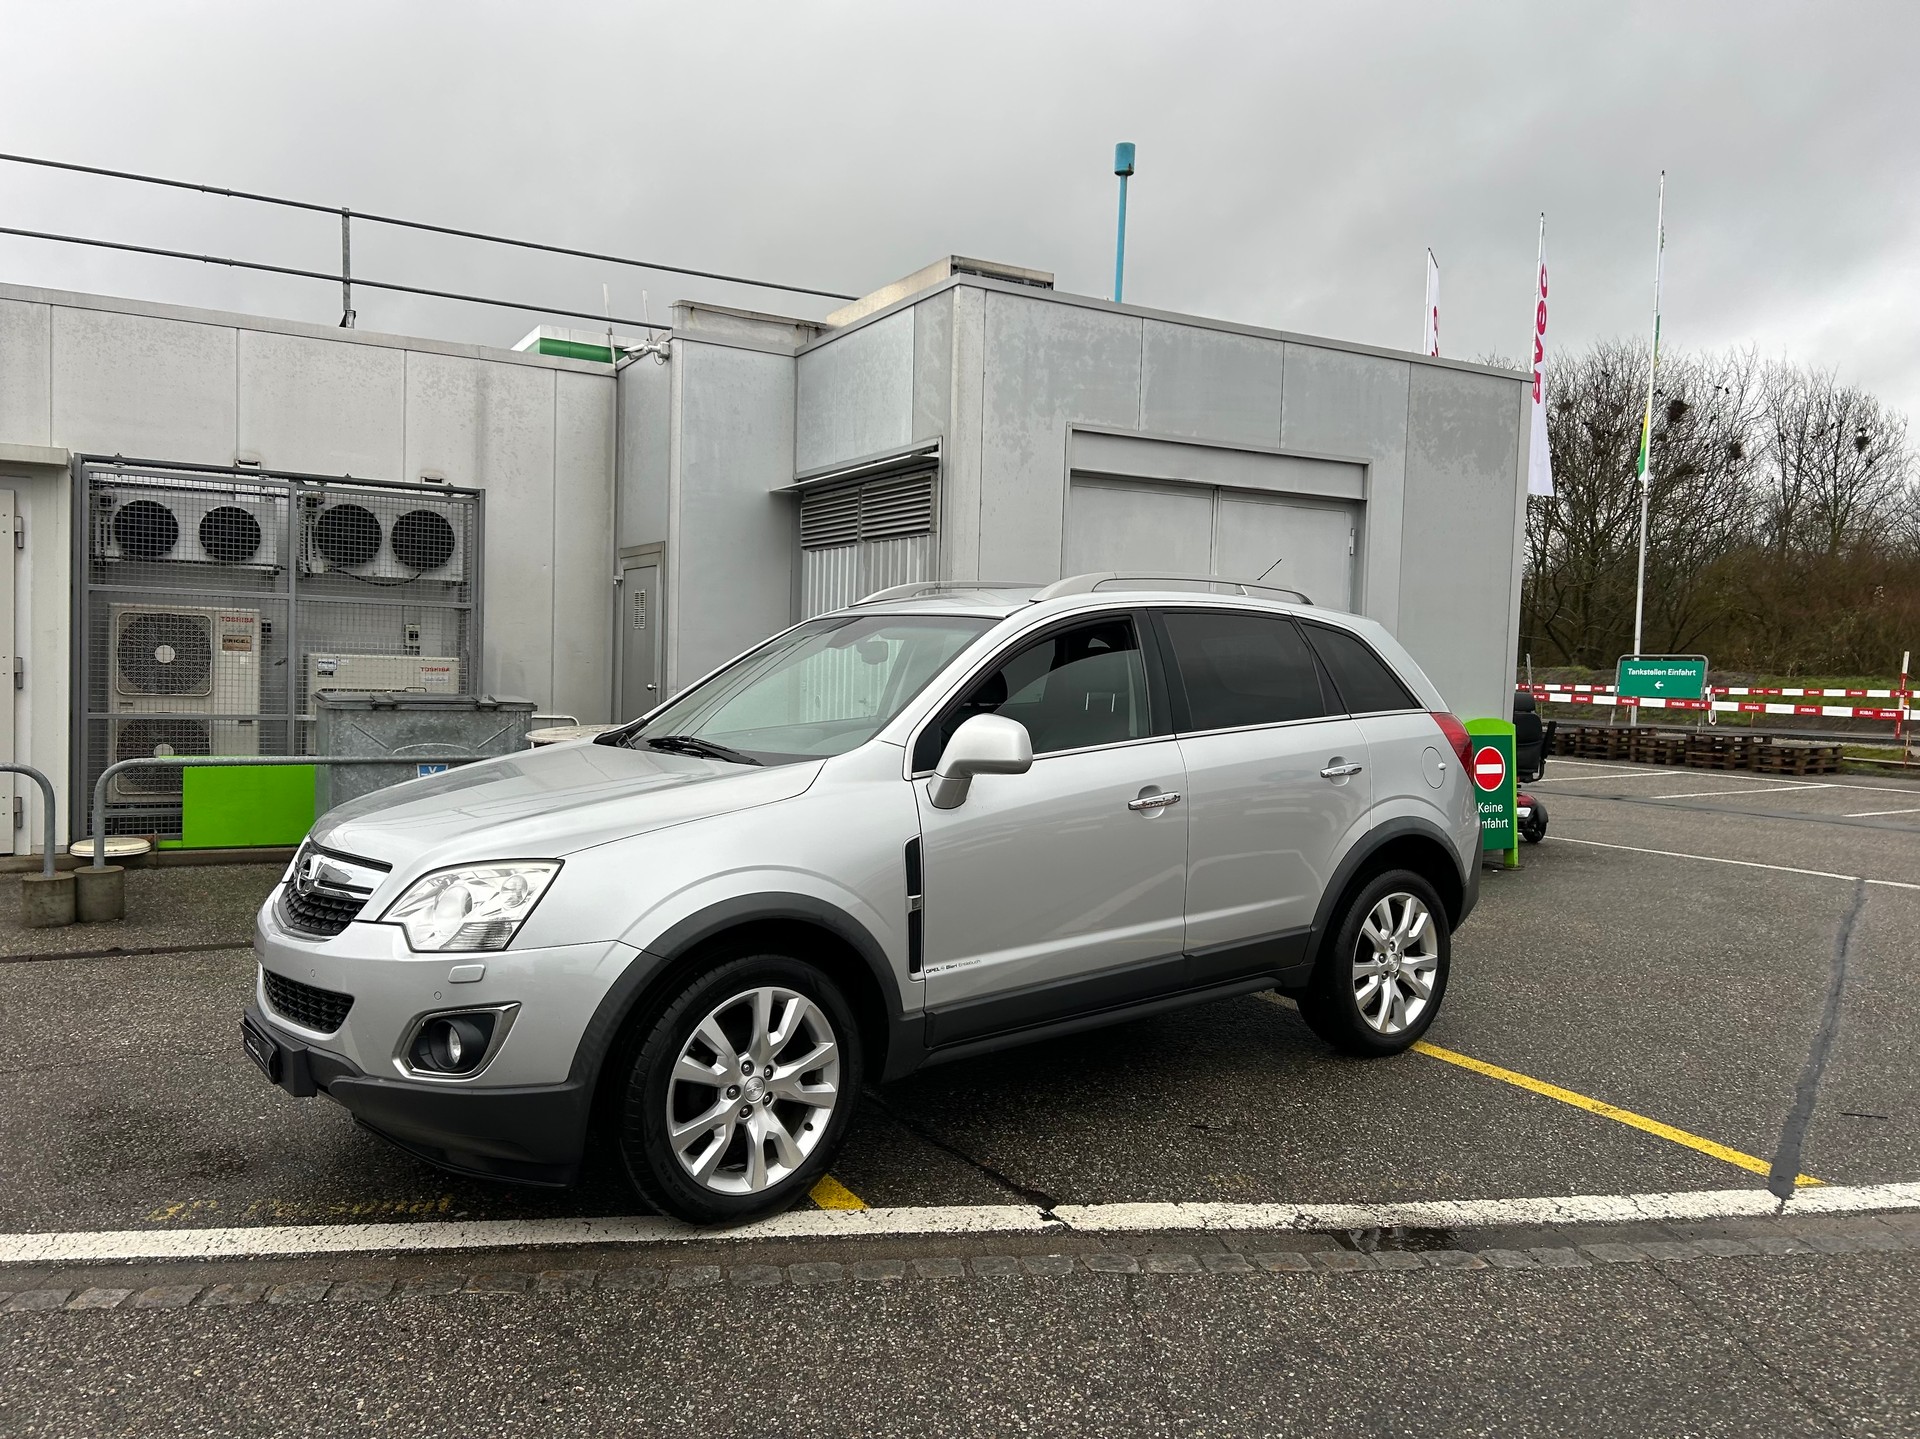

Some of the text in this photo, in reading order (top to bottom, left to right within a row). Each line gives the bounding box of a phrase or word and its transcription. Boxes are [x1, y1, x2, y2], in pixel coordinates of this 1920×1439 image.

[1627, 668, 1697, 677] Tankstellen Einfahrt
[1477, 802, 1504, 814] Keine
[1482, 817, 1509, 829] nfahrt
